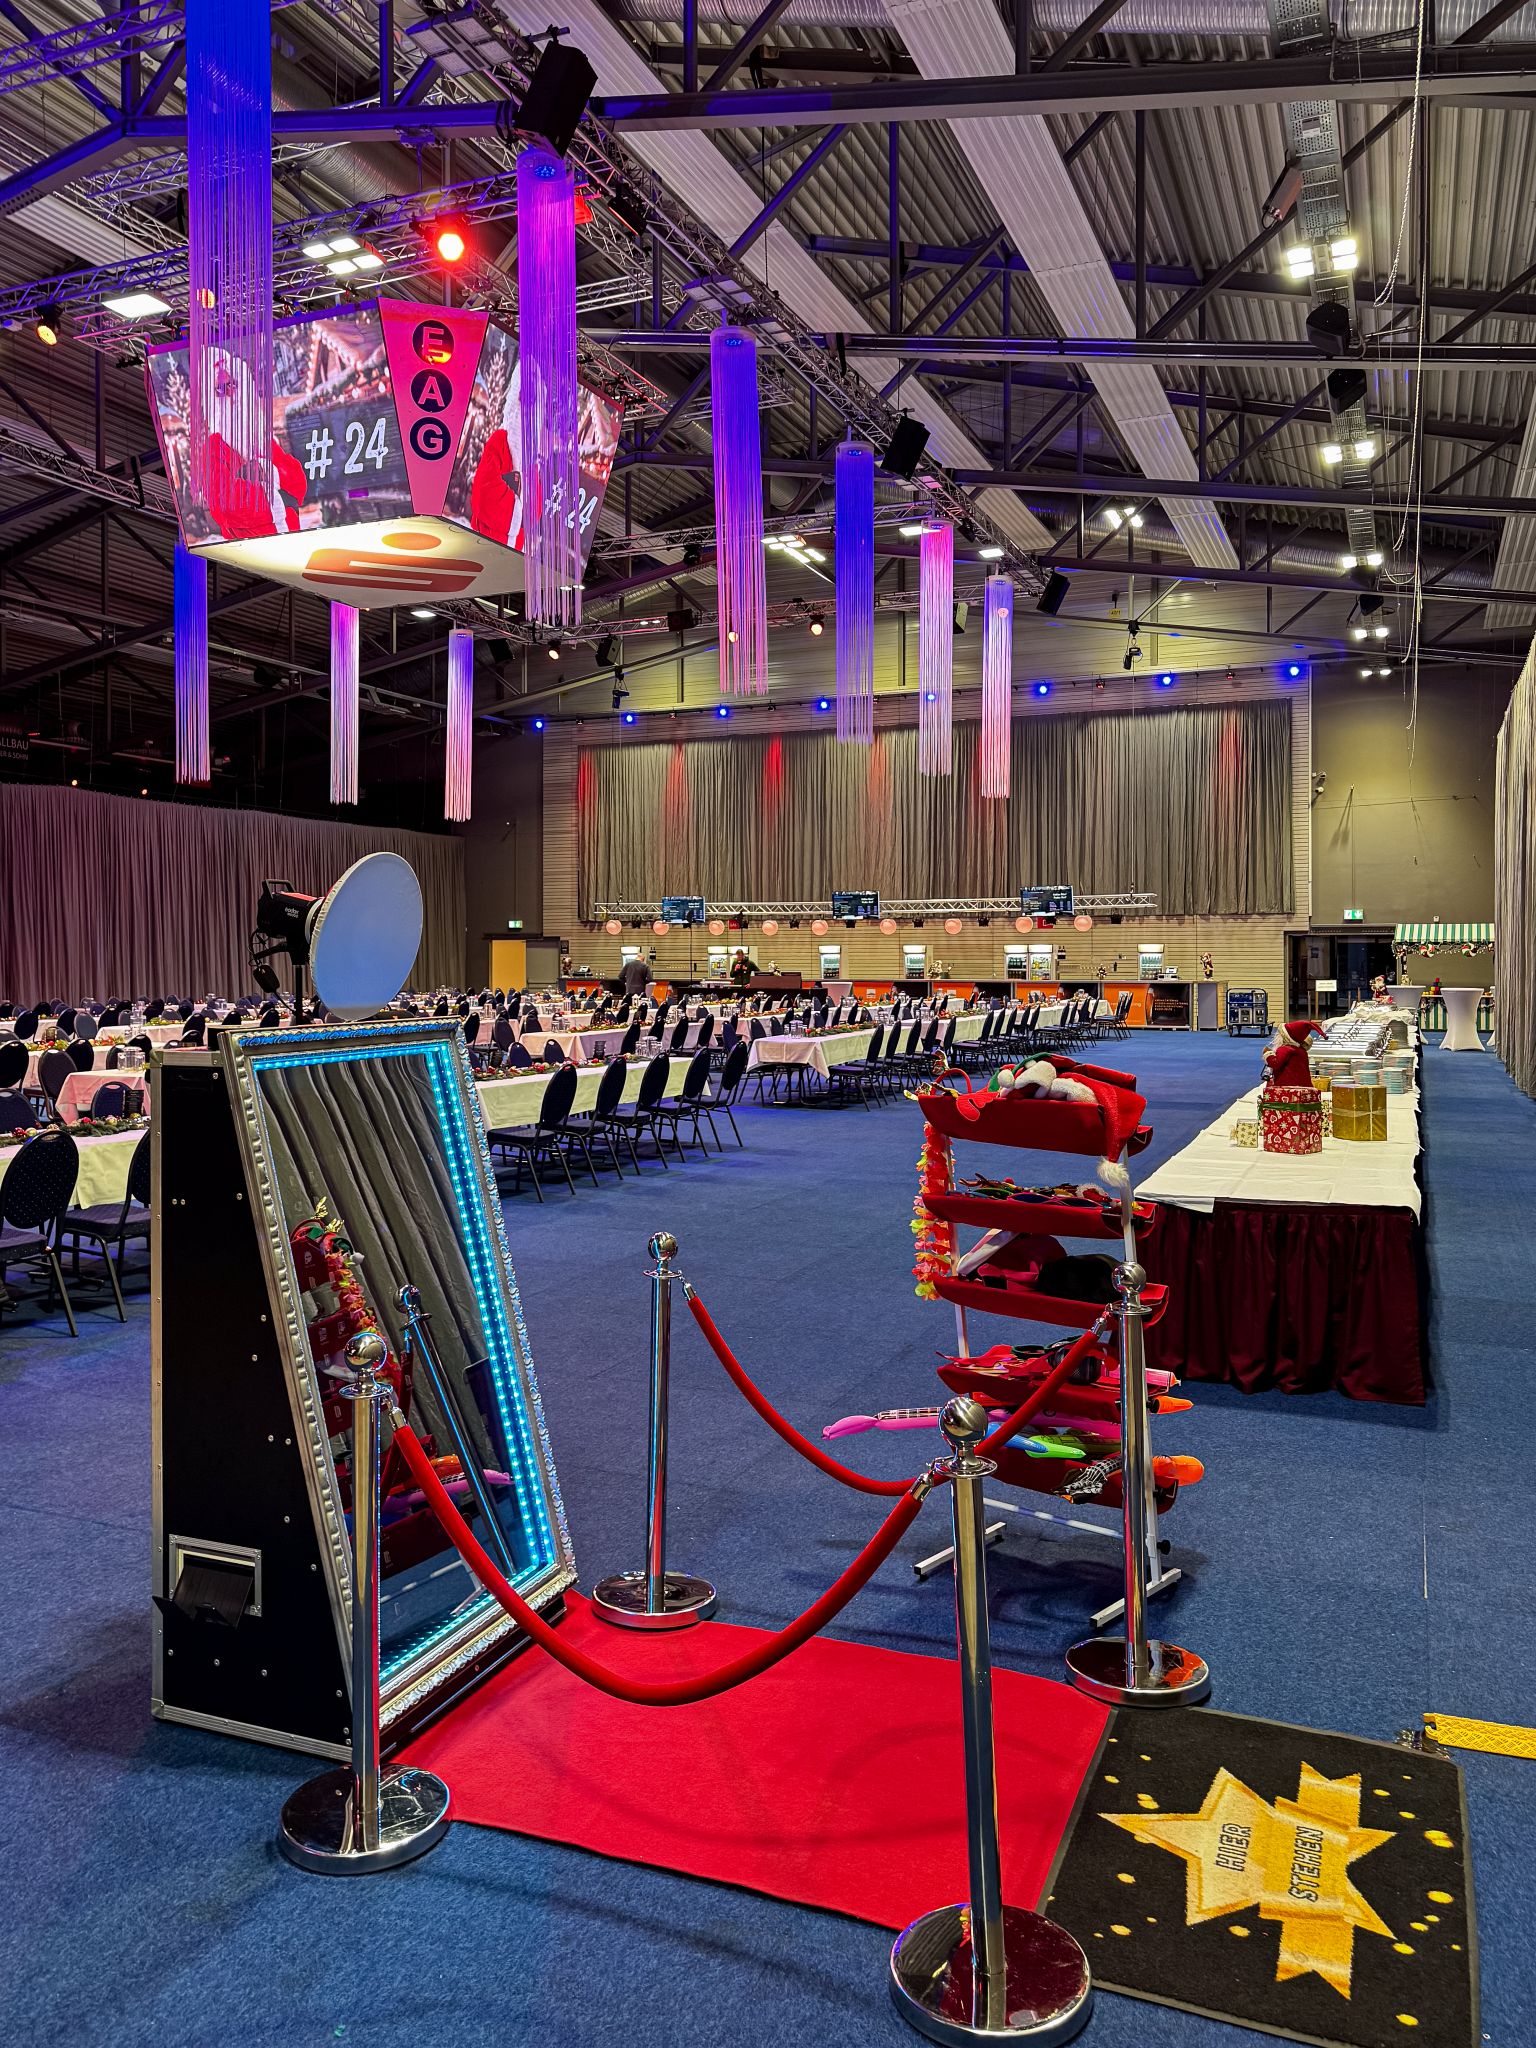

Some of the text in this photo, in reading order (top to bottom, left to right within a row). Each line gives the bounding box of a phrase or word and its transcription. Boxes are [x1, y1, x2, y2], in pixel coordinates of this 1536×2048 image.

[417, 326, 446, 454] EAG
[304, 417, 389, 480] # 24
[0, 736, 29, 751] LLBAU
[1215, 1822, 1252, 1872] HIER
[1287, 1825, 1324, 1903] STEHEN
